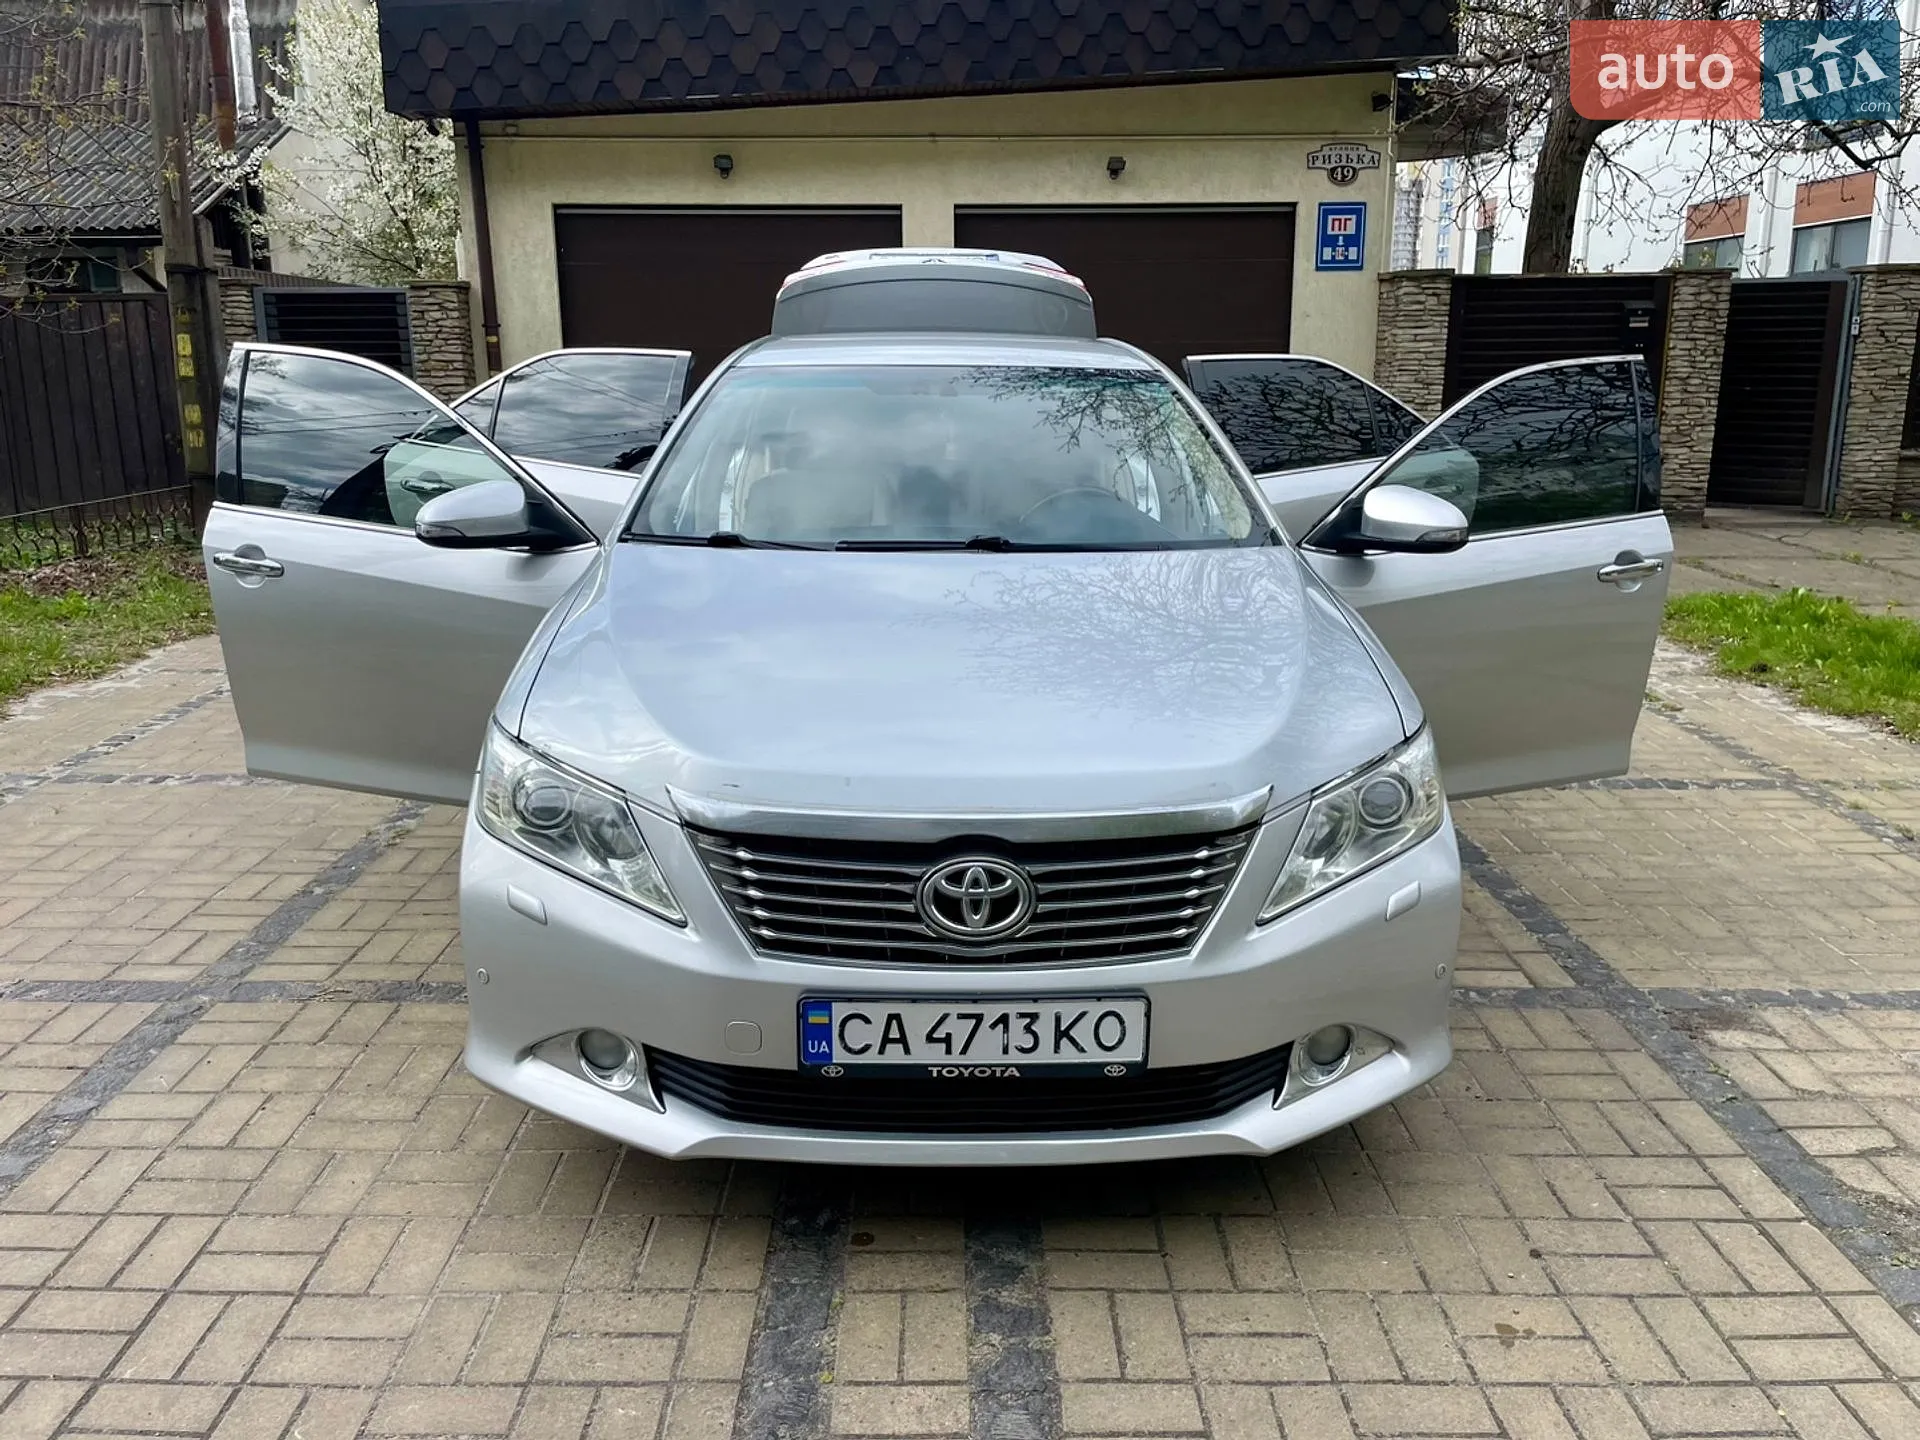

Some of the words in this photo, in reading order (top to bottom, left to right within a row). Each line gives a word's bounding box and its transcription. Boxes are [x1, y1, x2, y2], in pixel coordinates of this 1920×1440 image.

[1312, 154, 1376, 166] РИЗЬКА
[1333, 167, 1353, 180] 49
[1331, 218, 1352, 231] ПГ
[838, 1012, 912, 1056] CA
[925, 1011, 1040, 1056] 4713
[1053, 1009, 1127, 1055] KO
[808, 1039, 830, 1054] UA
[927, 1066, 1021, 1078] TOYOTA
